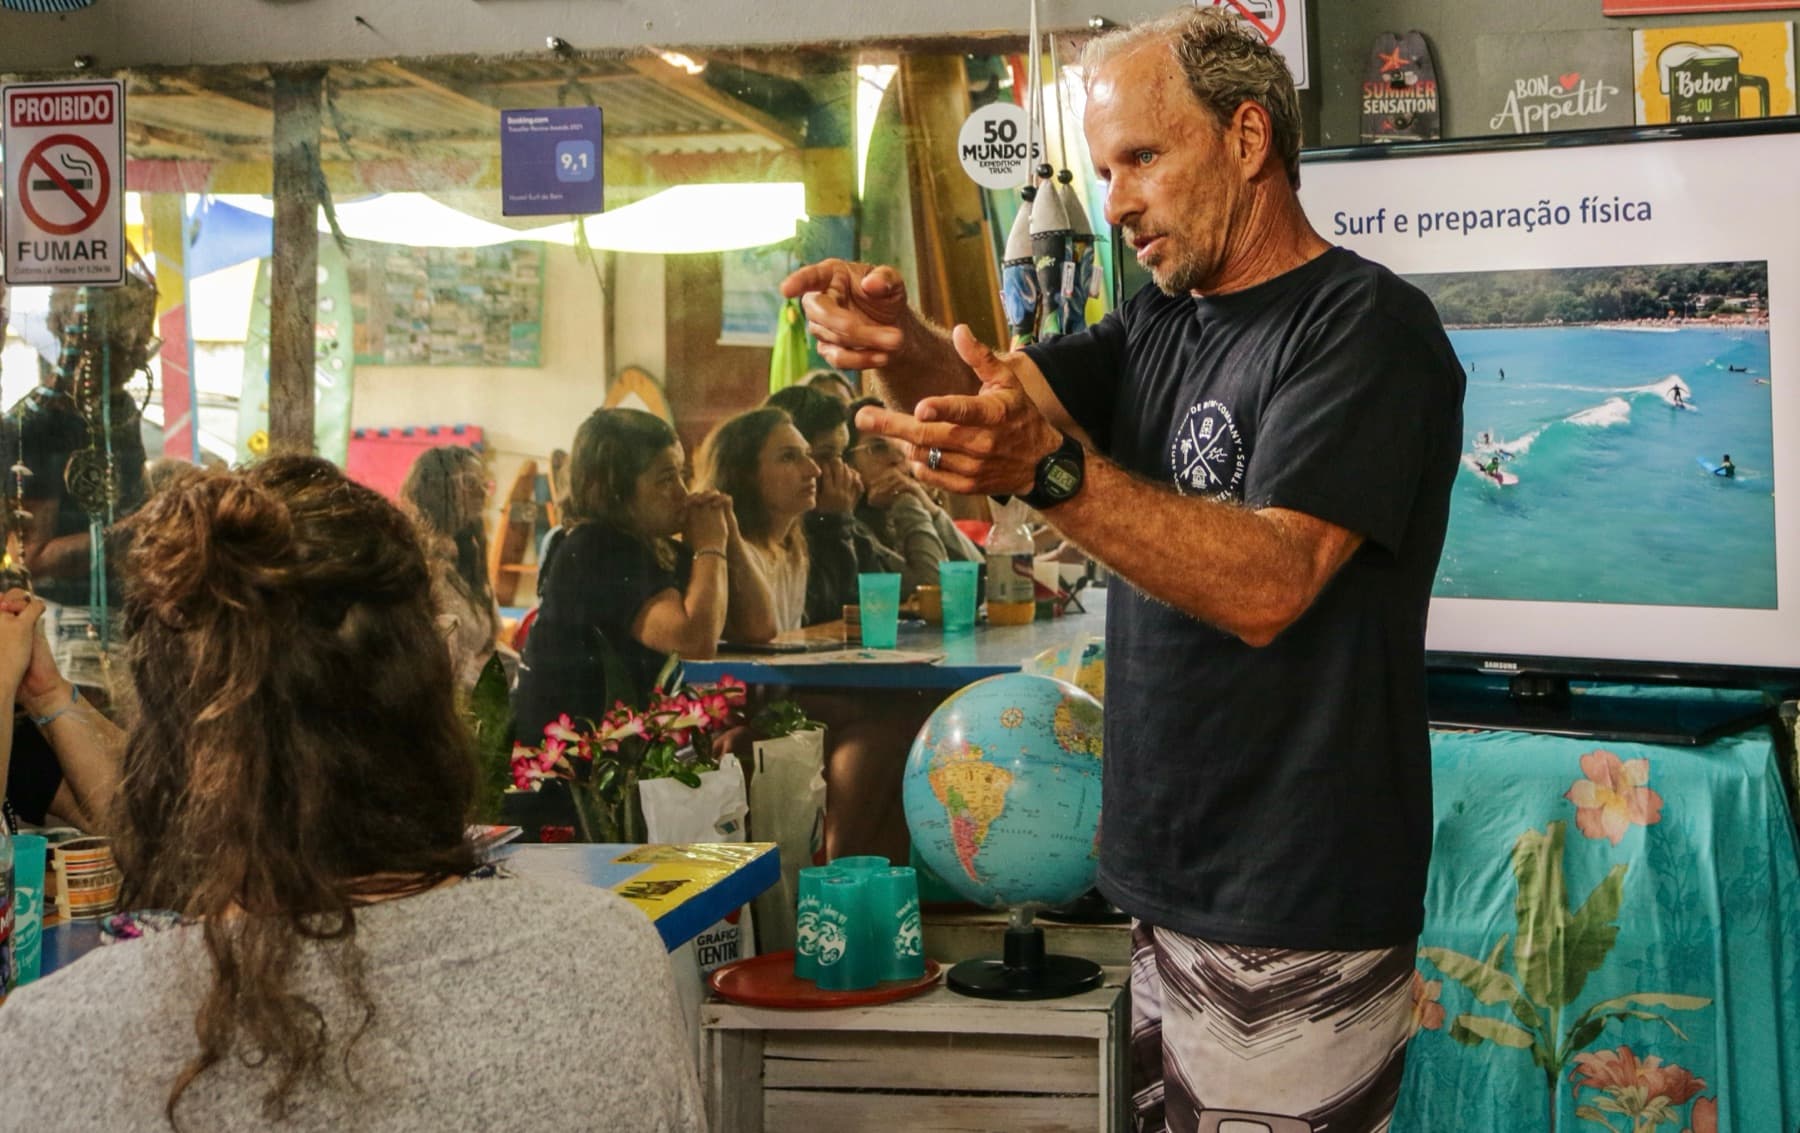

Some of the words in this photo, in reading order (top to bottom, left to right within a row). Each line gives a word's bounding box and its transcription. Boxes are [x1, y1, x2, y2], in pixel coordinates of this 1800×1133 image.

[1363, 81, 1436, 98] SUMMER
[1515, 75, 1548, 99] BON
[1676, 70, 1732, 98] Beber
[14, 95, 110, 123] PROIBIDO
[1363, 99, 1436, 114] SENSATION
[1490, 80, 1619, 133] Appetit
[1697, 99, 1712, 112] OU
[984, 119, 1017, 143] 50
[561, 153, 588, 171] 9,1
[963, 143, 1040, 160] MUNDOS
[1333, 208, 1386, 236] Surf
[1394, 213, 1408, 232] e
[1417, 200, 1570, 237] preparação
[1579, 196, 1651, 223] física
[18, 240, 107, 260] FUMAR
[1217, 403, 1243, 445] COMPANY
[1231, 454, 1245, 485] TRIPS
[1484, 661, 1517, 669] SAMSUNG
[698, 942, 738, 967] CENTR
